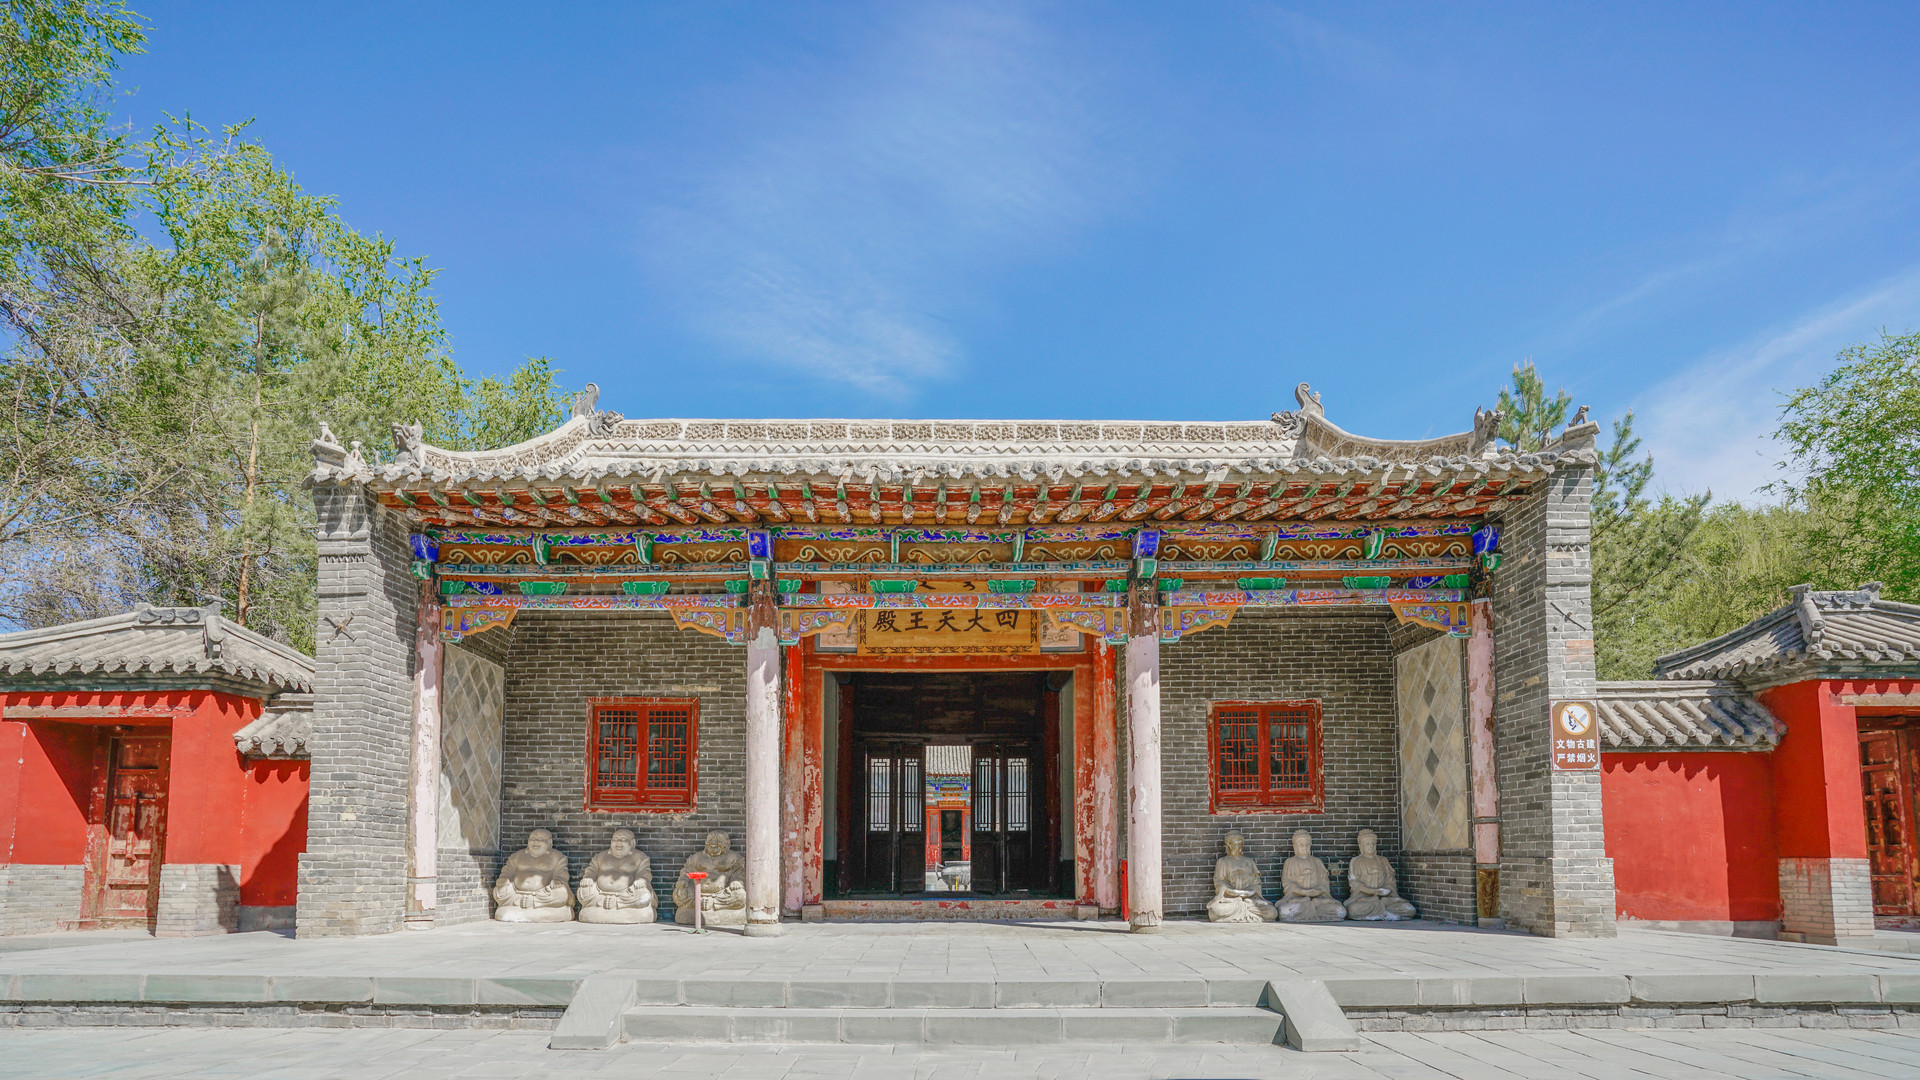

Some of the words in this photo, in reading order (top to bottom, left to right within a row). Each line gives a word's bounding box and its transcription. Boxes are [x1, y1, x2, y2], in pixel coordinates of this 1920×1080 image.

[1556, 739, 1596, 749] 文物古建
[1556, 753, 1596, 763] 严禁烟火
